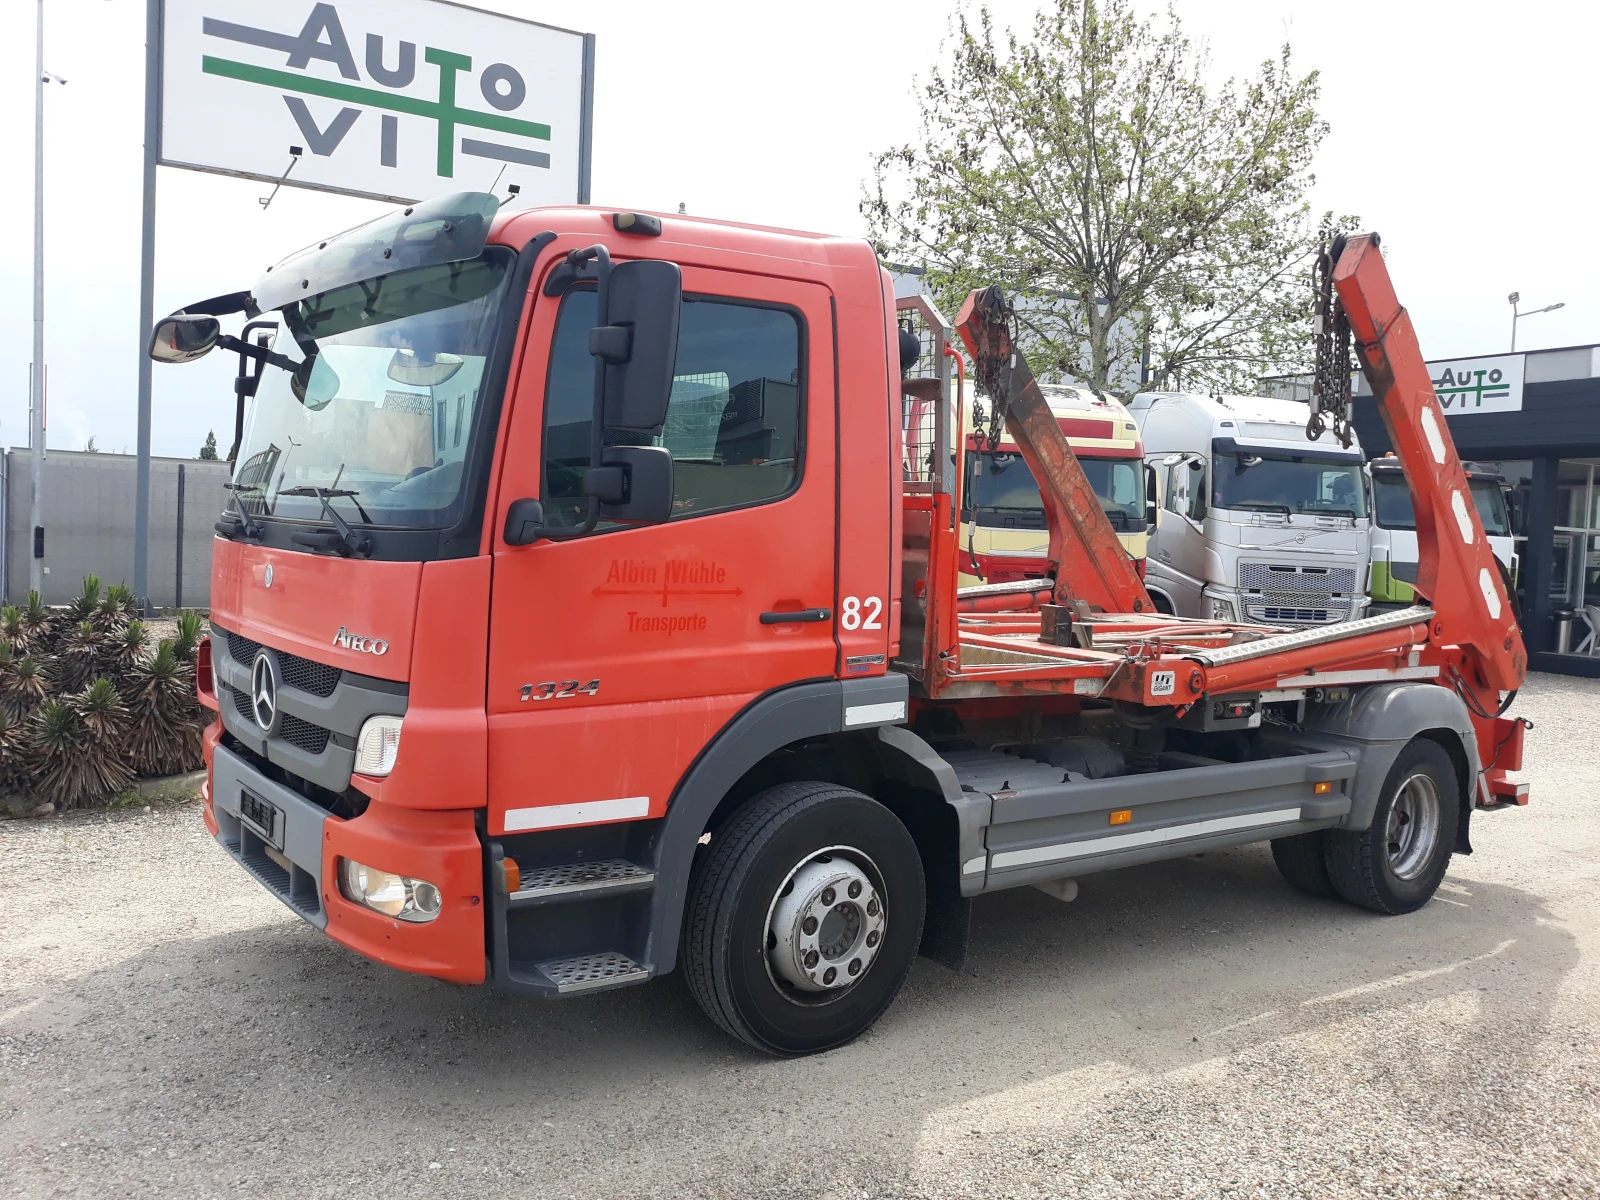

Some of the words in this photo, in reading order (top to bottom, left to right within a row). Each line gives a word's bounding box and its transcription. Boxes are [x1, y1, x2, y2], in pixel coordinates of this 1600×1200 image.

[286, 2, 526, 112] AUTO
[1438, 368, 1503, 388] AUTO
[606, 559, 657, 584] Albin
[664, 559, 726, 584] Mühle
[627, 611, 707, 637] Transporte
[841, 596, 883, 630] 82
[332, 625, 389, 656] ATEGO
[518, 678, 600, 702] 1324
